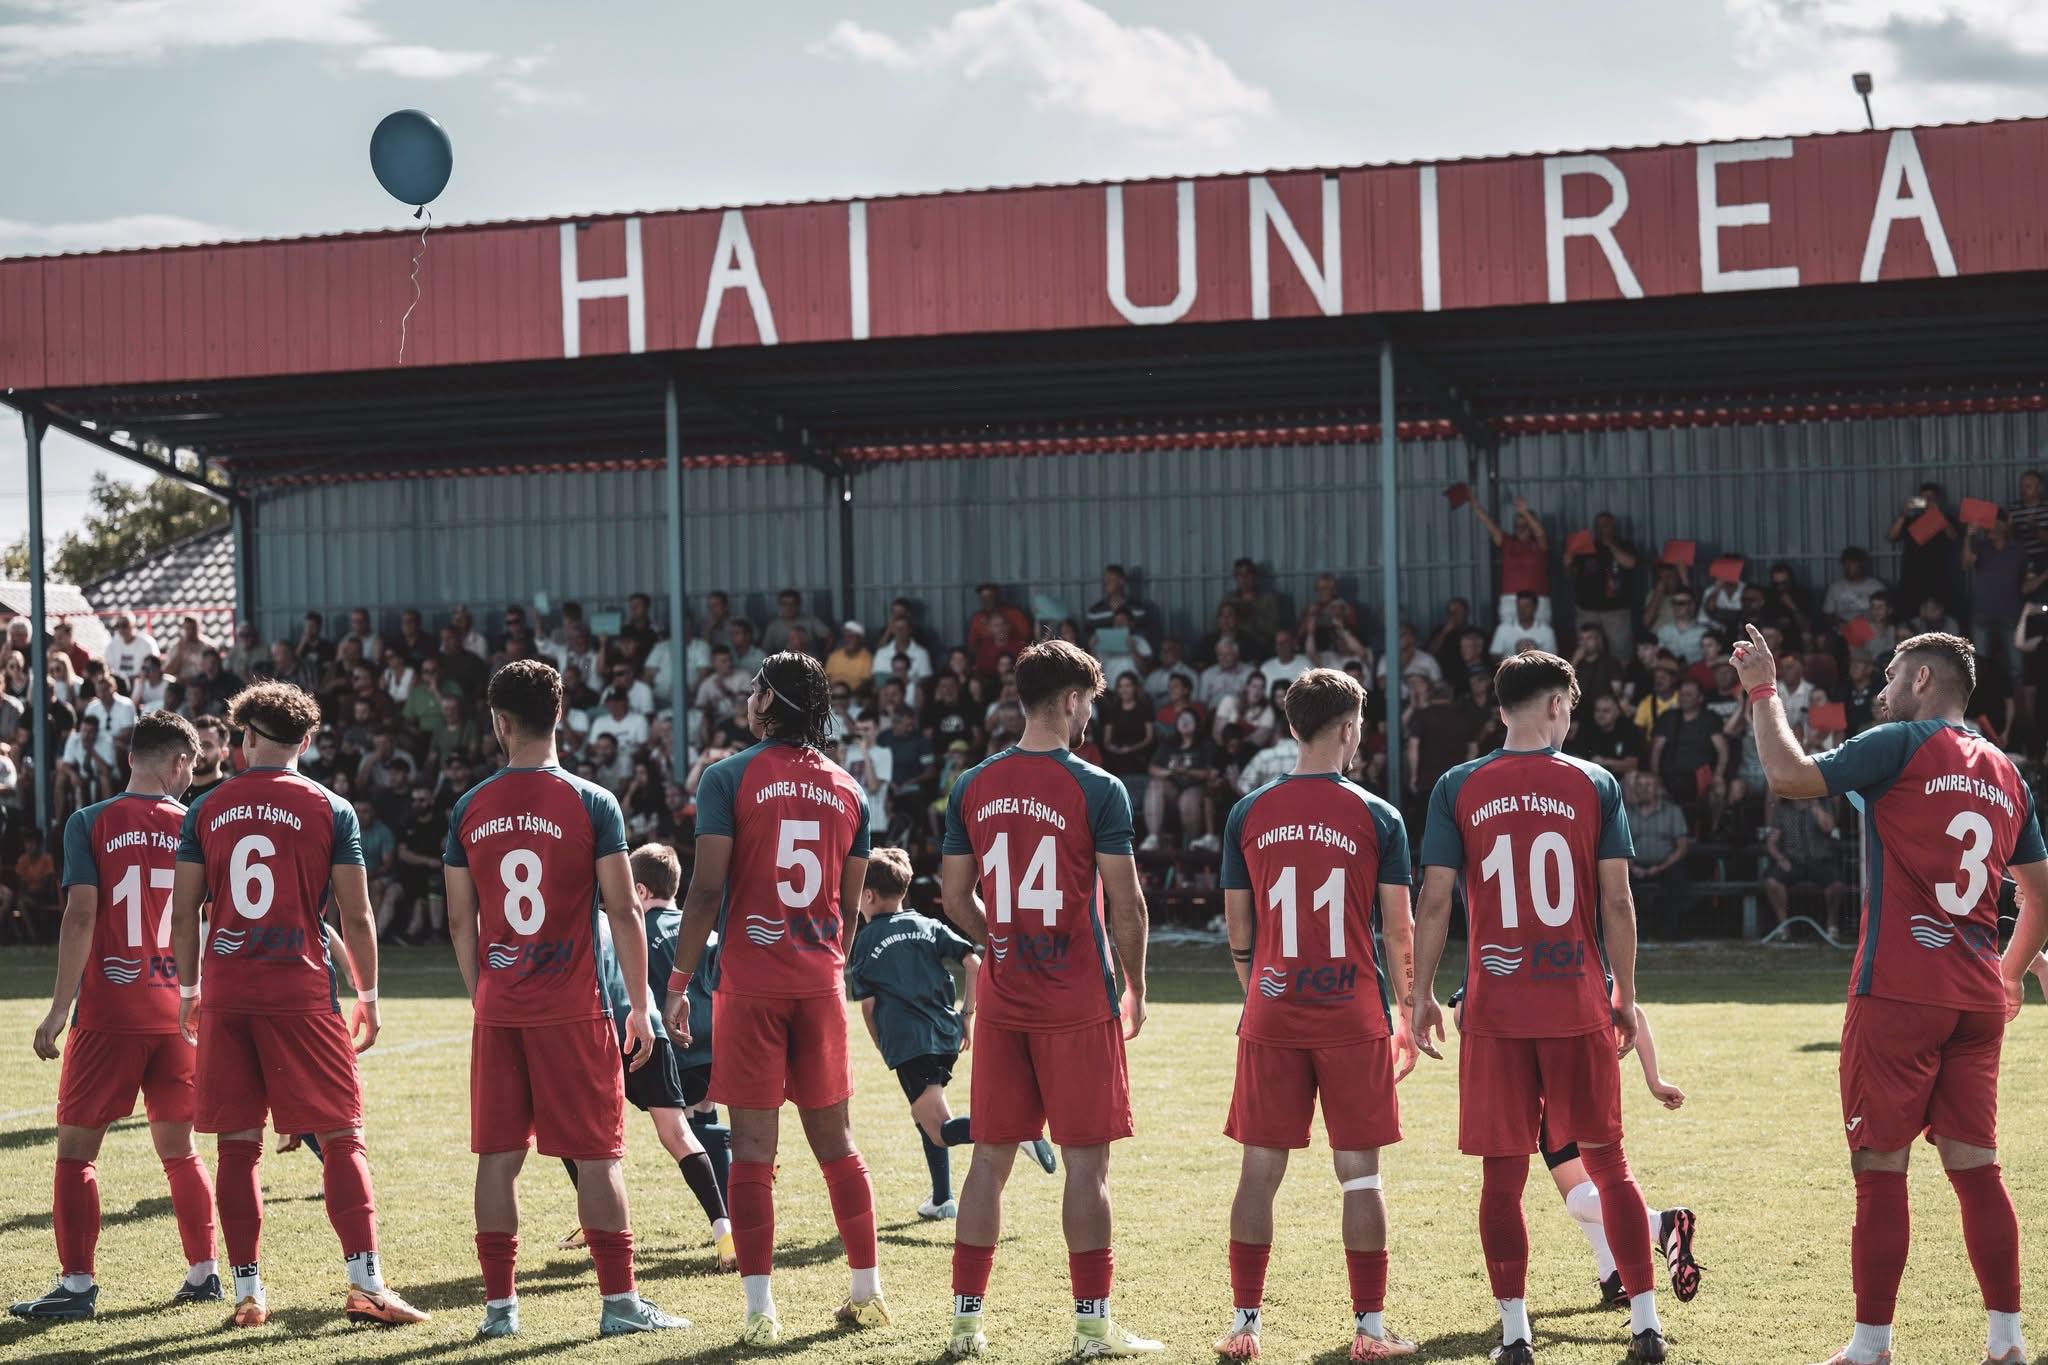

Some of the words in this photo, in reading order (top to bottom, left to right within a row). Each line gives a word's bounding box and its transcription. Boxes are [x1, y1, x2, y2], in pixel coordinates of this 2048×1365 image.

[560, 201, 869, 358] HAI
[1107, 129, 1958, 324] UNIREA
[756, 782, 797, 804] UNIREA
[1925, 775, 1973, 796] UNIREA
[210, 805, 254, 833] UNIREA
[977, 798, 1019, 823] UNIREA
[1472, 796, 1519, 827] UNIREA
[106, 831, 147, 853] UNIREA
[470, 817, 513, 844] UNIREA
[1257, 825, 1304, 850] UNIREA
[230, 835, 275, 919] 6
[776, 819, 822, 908] 5
[1935, 811, 1993, 916] 3
[500, 849, 545, 936] 8
[982, 832, 1063, 927] 14
[1481, 832, 1575, 929] 10
[113, 865, 176, 949] 17
[1268, 867, 1346, 958] 11
[149, 956, 177, 978] FG
[963, 1296, 981, 1311] FS
